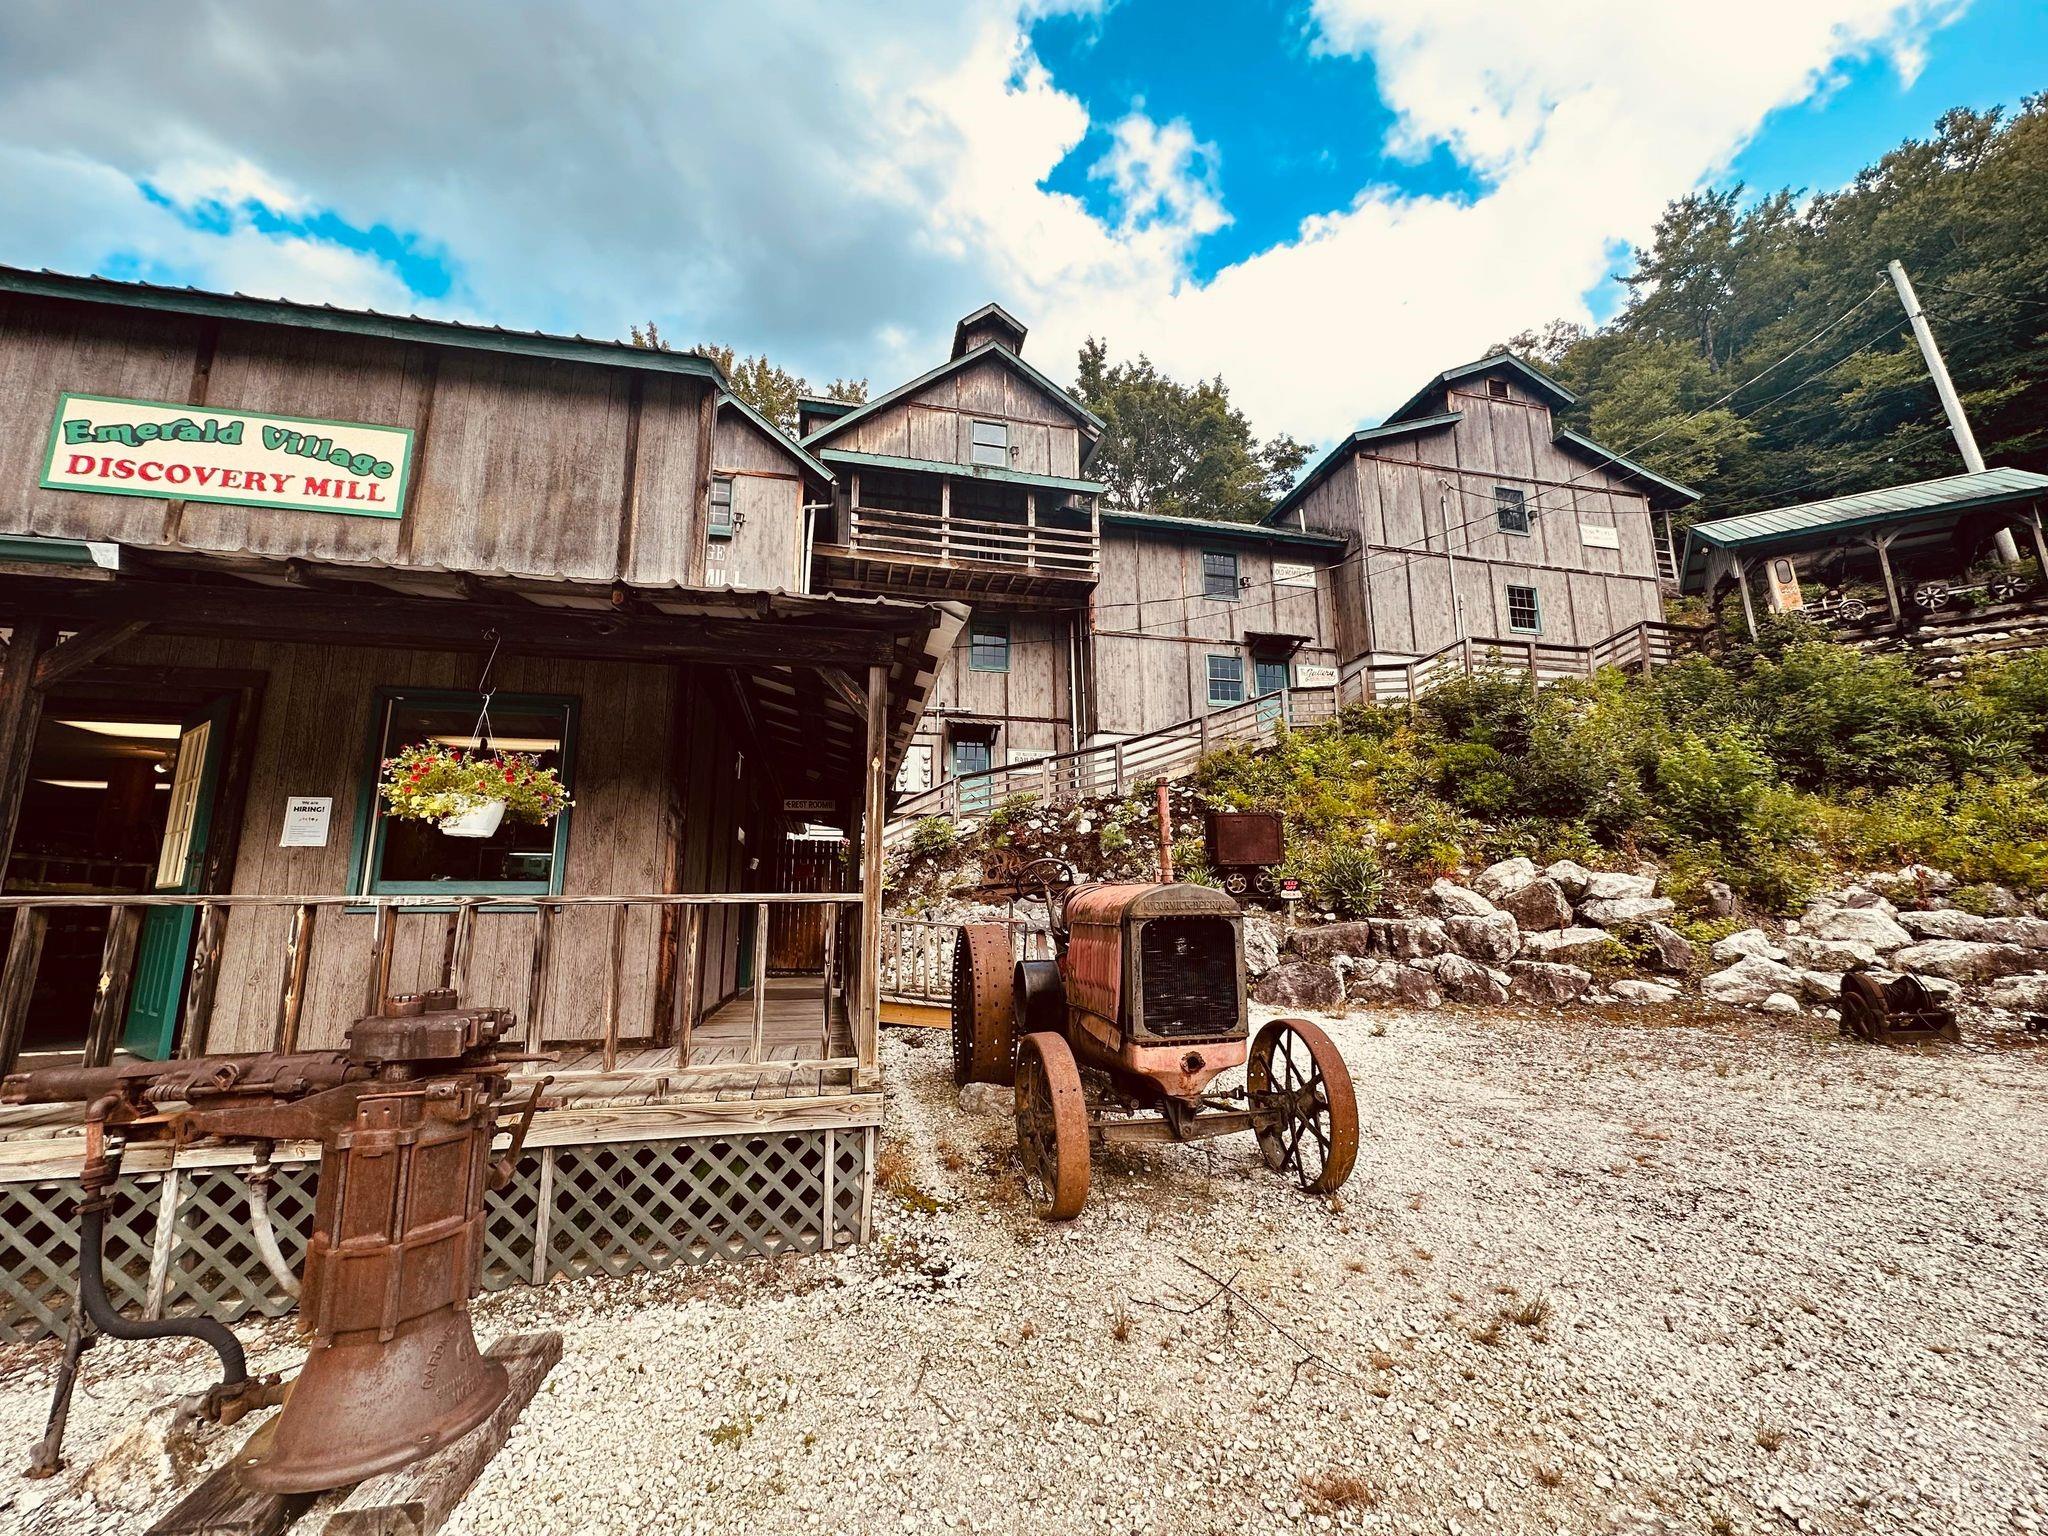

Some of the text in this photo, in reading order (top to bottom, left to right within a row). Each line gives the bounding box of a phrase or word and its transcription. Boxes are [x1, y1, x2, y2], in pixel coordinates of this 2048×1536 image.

[63, 418, 394, 479] Emerald Village
[65, 454, 386, 503] DISCOVERY MILL
